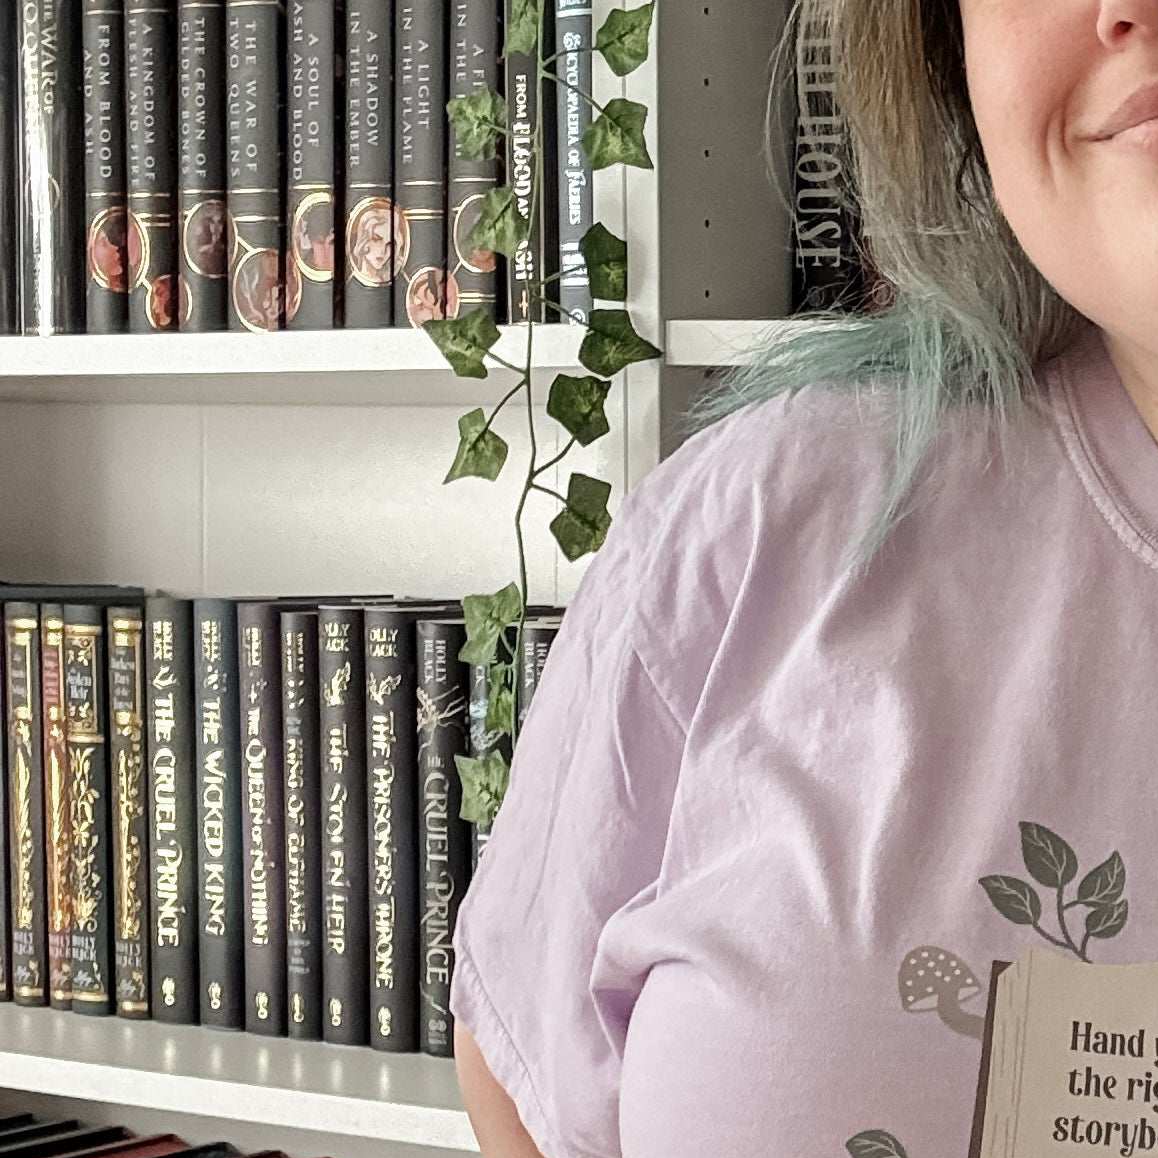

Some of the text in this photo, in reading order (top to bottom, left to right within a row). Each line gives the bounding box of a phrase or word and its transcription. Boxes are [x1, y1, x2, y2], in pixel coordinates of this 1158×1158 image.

[128, 18, 137, 78] FLESH
[181, 22, 190, 98] GILDED
[456, 4, 467, 27] IN
[456, 40, 467, 81] THE
[472, 44, 485, 57] A
[84, 50, 93, 154] AND ASH
[98, 25, 112, 178] FROM BLOOD
[129, 91, 138, 131] AND
[143, 23, 155, 180] A KINGDOM OF
[194, 18, 206, 178] THE CROWN OF
[228, 18, 240, 177] TWO QUEENS
[245, 21, 257, 172] THE WAR OF
[293, 3, 303, 180] ASH AND BLOOD
[308, 34, 320, 147] A SOUL OF
[350, 12, 361, 169] IN THE EMBER
[366, 30, 379, 146] A SHADOW
[402, 8, 413, 165] IN THE FLAME
[417, 40, 429, 129] A LIGHT
[515, 74, 527, 119] FROM
[796, 116, 842, 269] HOUSE
[423, 640, 435, 683] BLACK
[435, 640, 447, 683] HOLLY
[152, 692, 186, 949] THE CRUEL PRINCE
[202, 697, 226, 937] THE WICKED KING
[245, 738, 268, 827] QUEEN
[423, 772, 450, 872] CRUEL
[371, 711, 396, 989] THE THRONE
[420, 872, 456, 985] PRINCE
[1067, 1066, 1117, 1099] the
[1070, 1021, 1145, 1058] Hand
